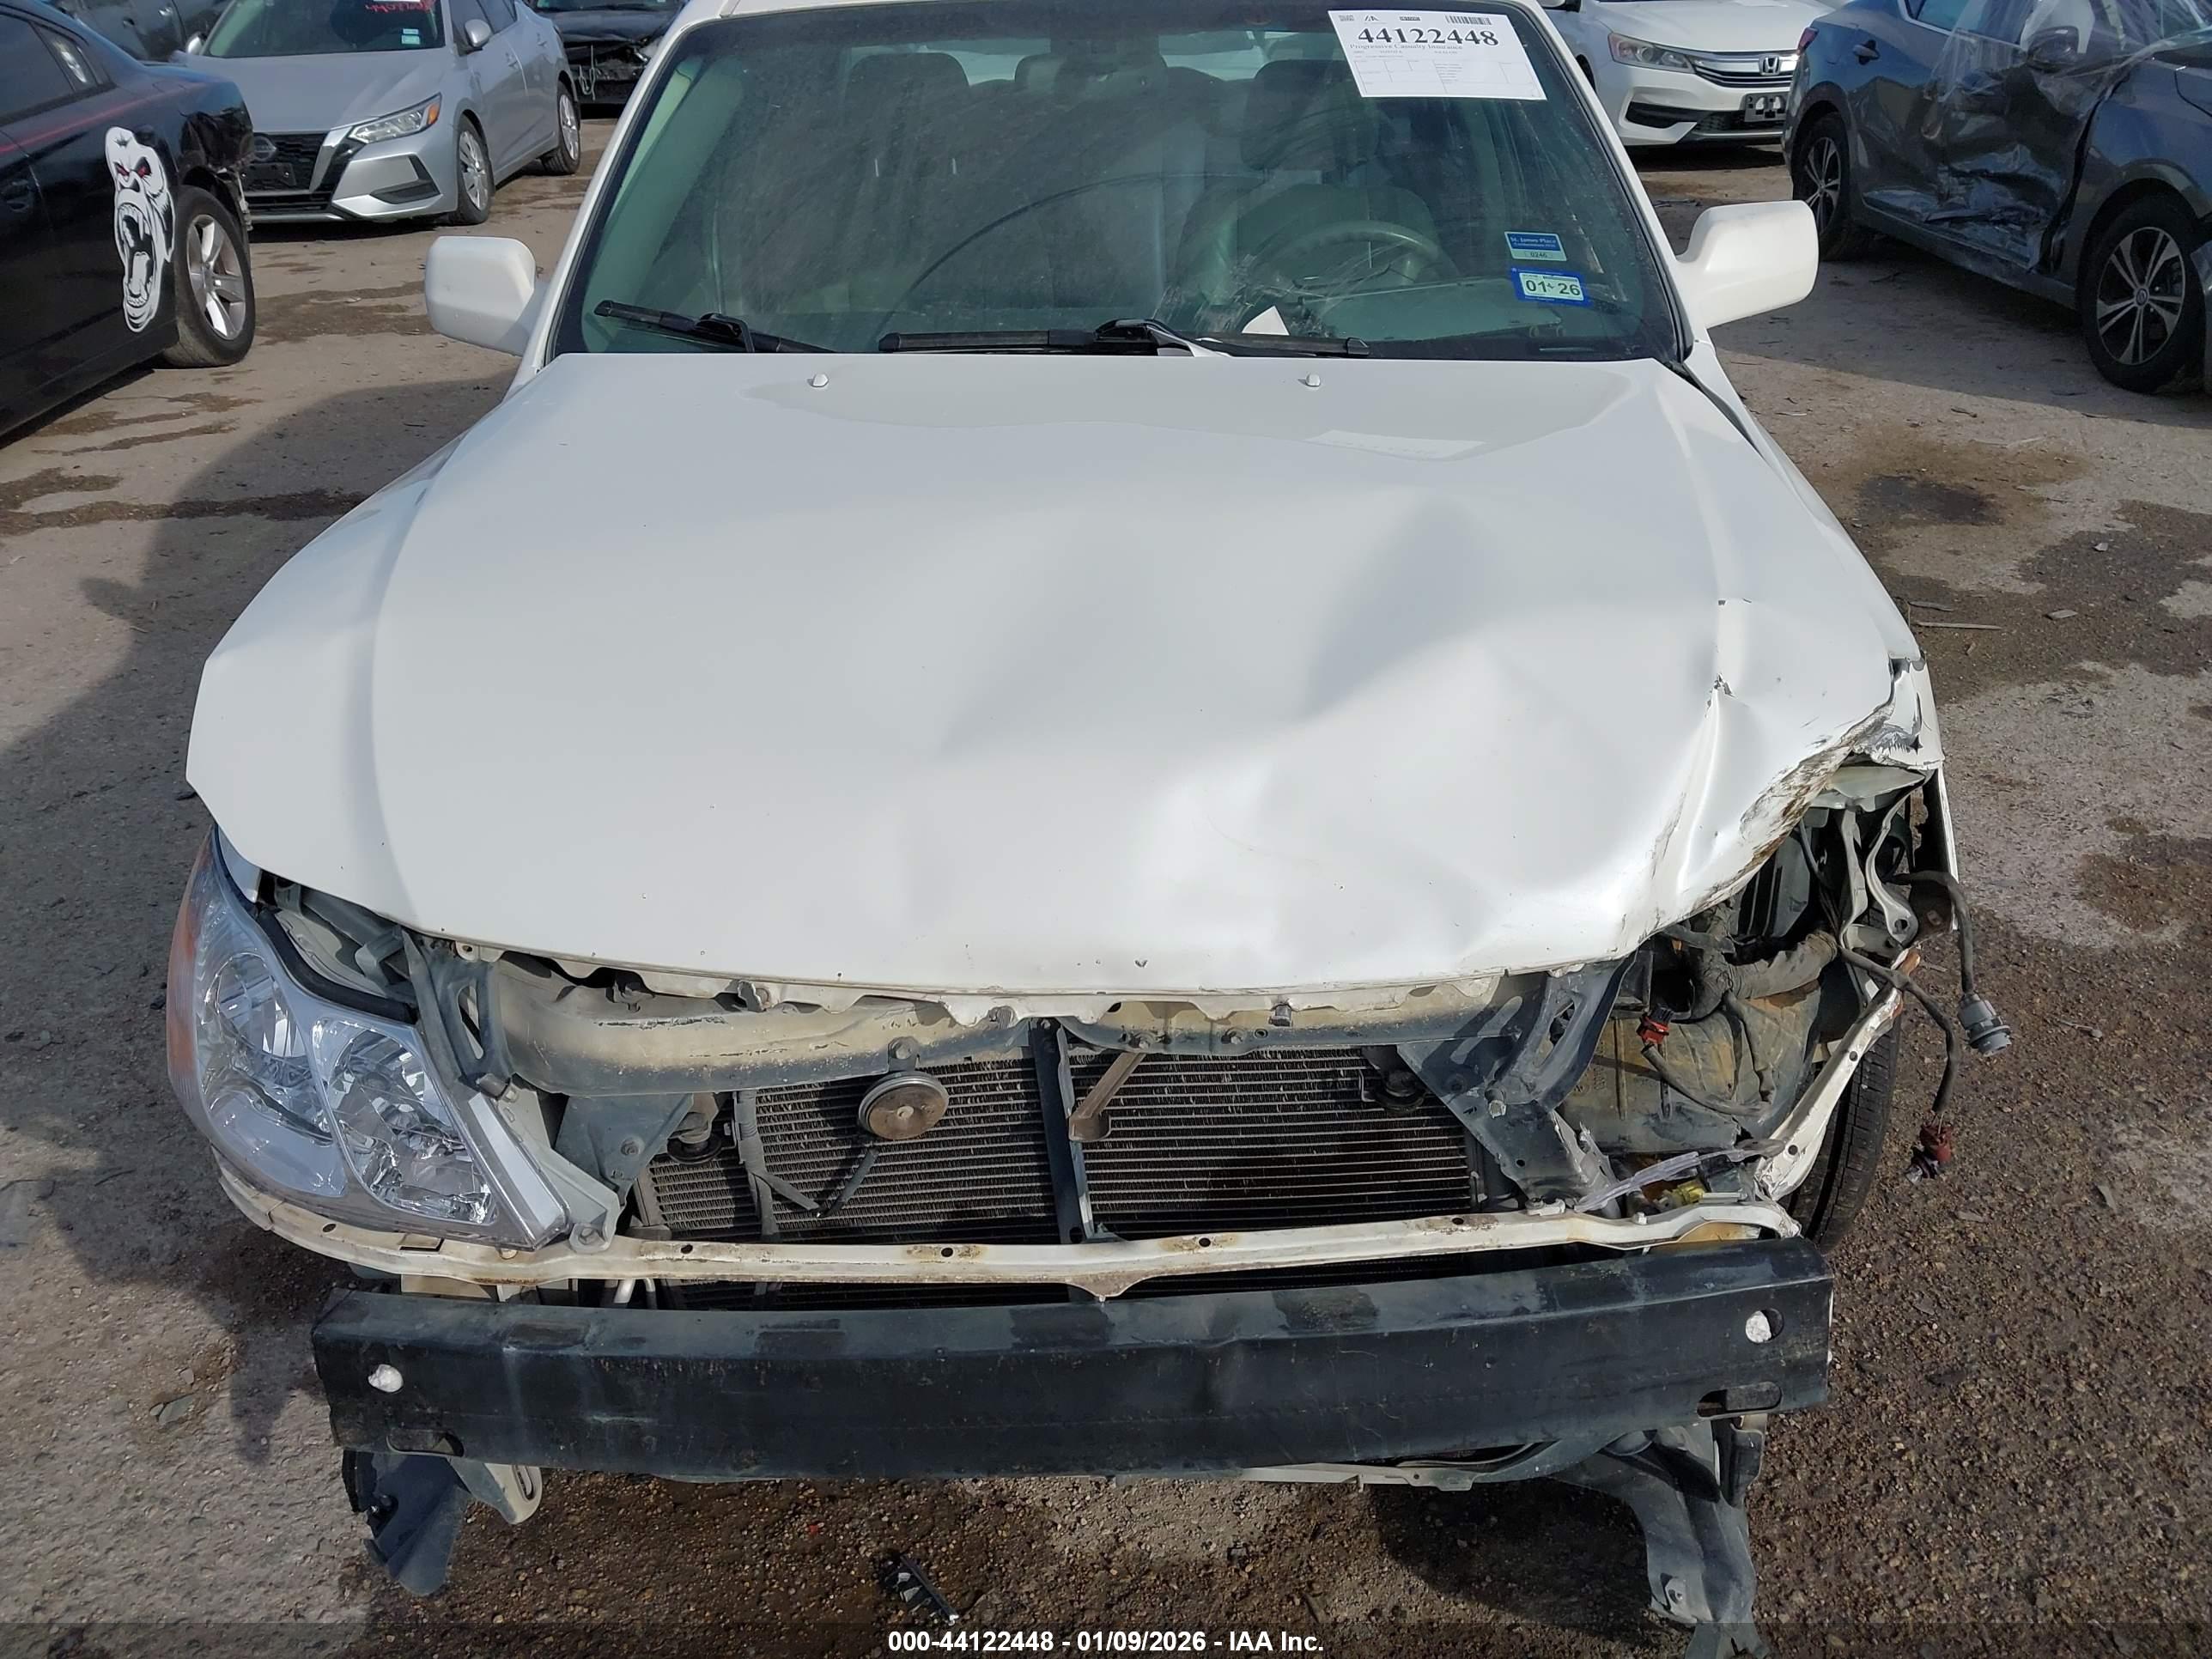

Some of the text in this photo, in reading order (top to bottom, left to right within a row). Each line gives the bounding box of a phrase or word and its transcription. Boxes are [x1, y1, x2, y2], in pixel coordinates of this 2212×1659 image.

[1358, 27, 1498, 46] 44122448
[1526, 280, 1581, 296] 01 26
